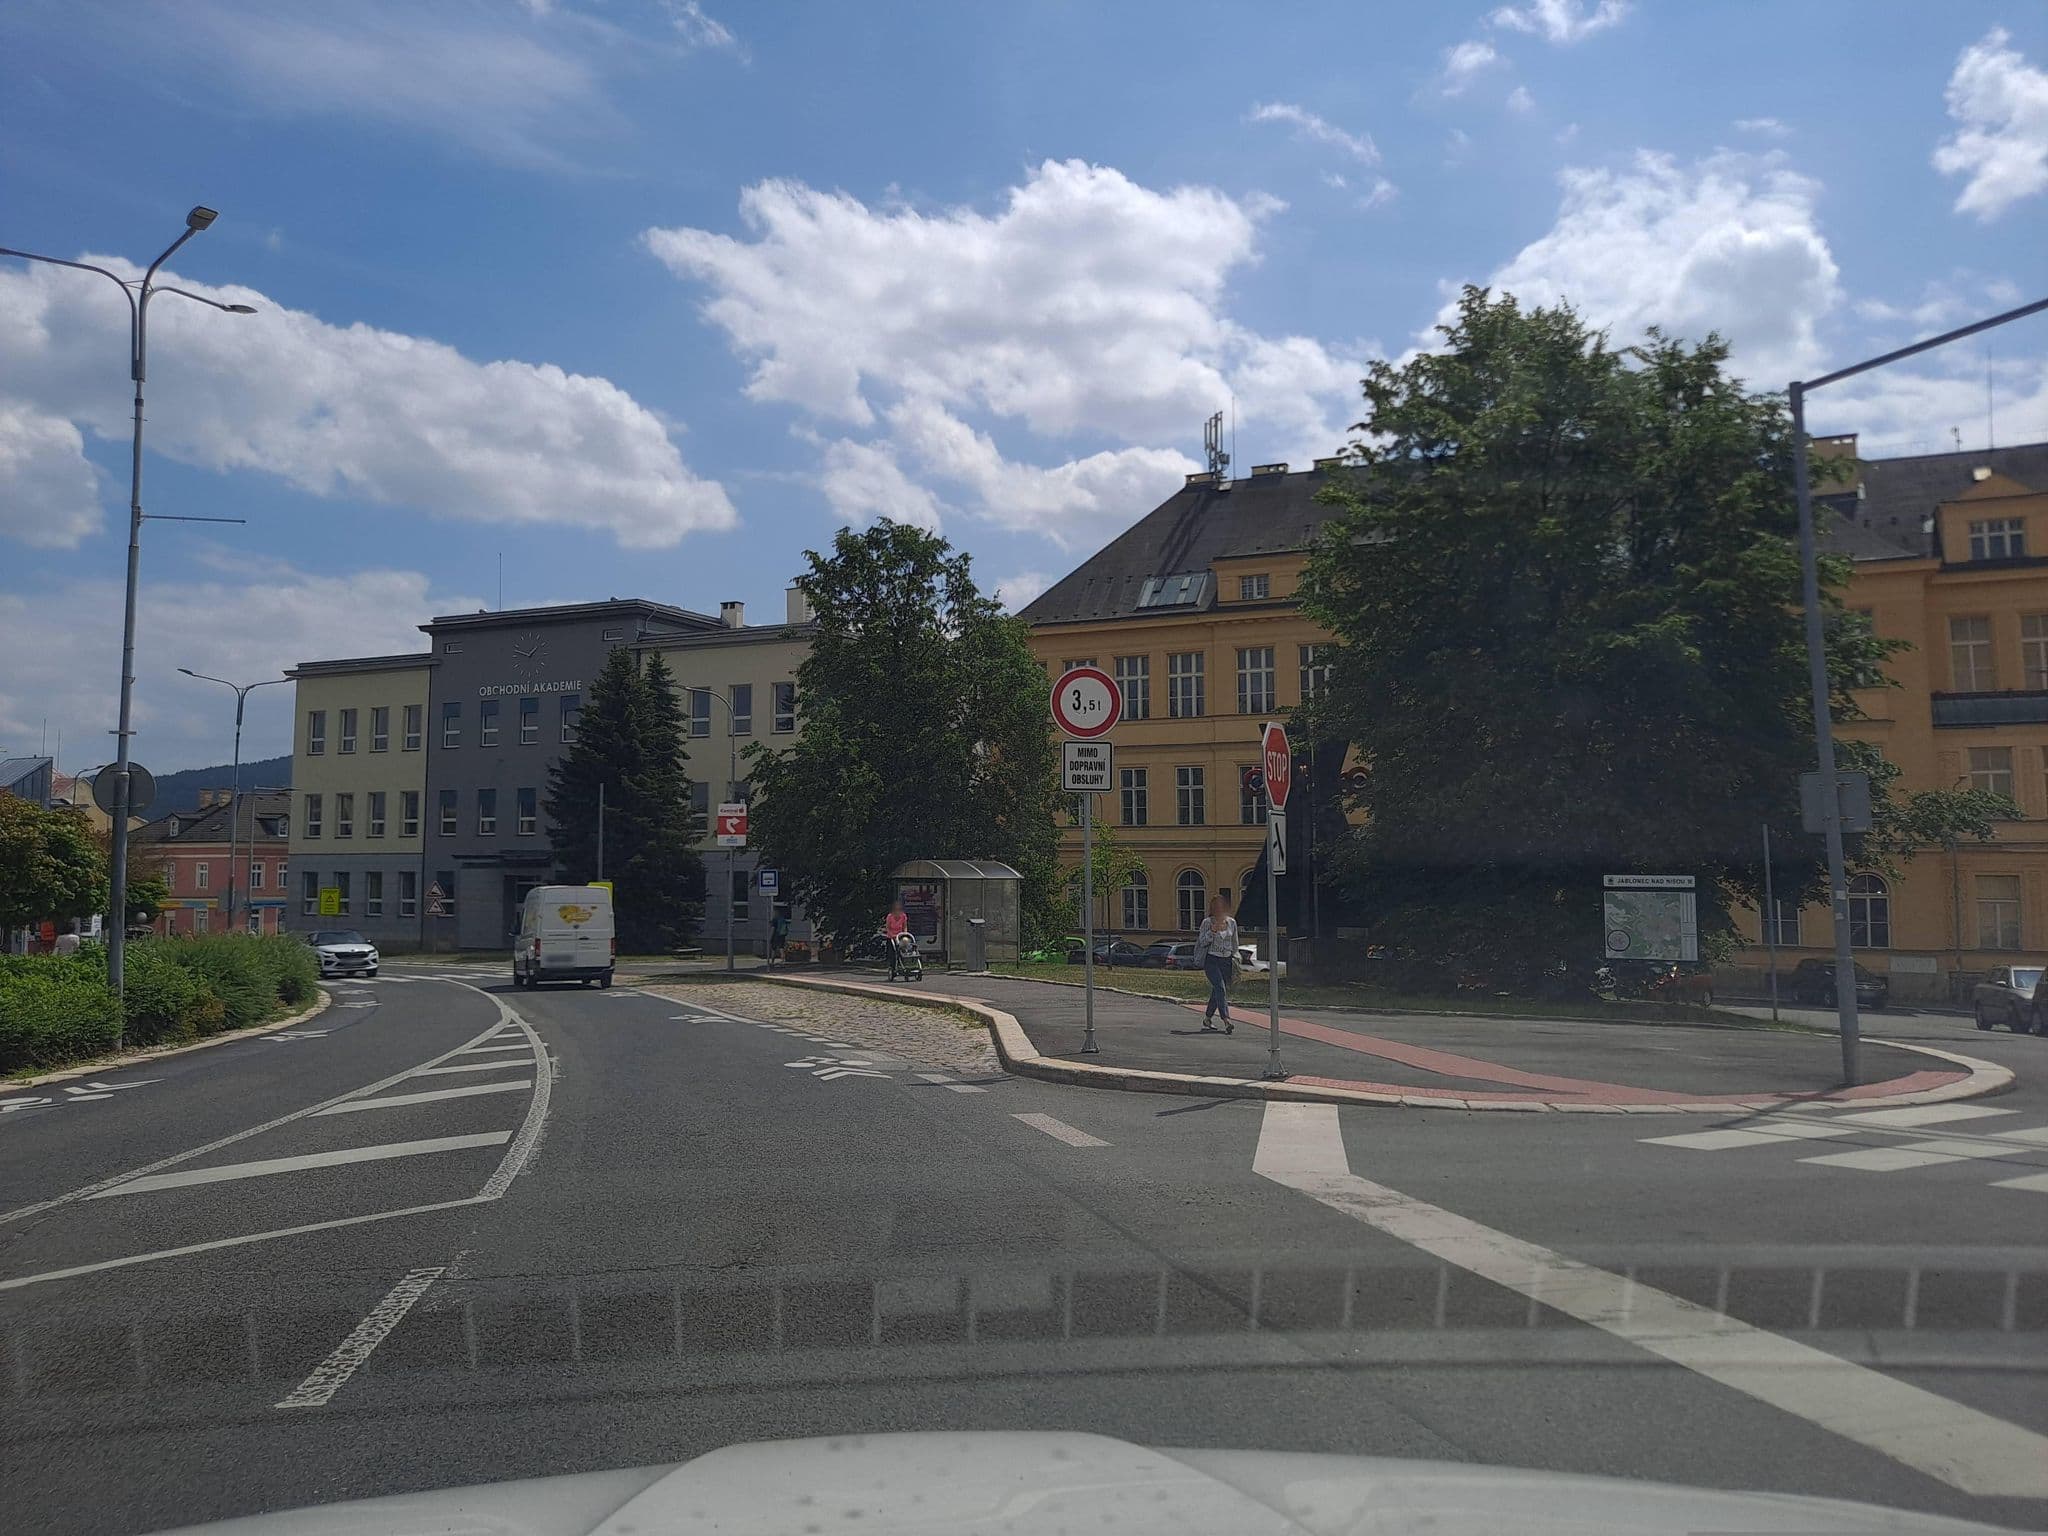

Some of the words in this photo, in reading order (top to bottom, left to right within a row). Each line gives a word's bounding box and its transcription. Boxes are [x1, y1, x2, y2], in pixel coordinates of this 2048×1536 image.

[479, 681, 530, 696] OBCHODNÍ
[533, 680, 582, 693] AKADEMIE
[1077, 747, 1098, 758] MIMO
[1069, 758, 1106, 771] DOPRAVNÍ
[1267, 750, 1288, 782] STOP
[1071, 773, 1104, 785] OBSLUHY
